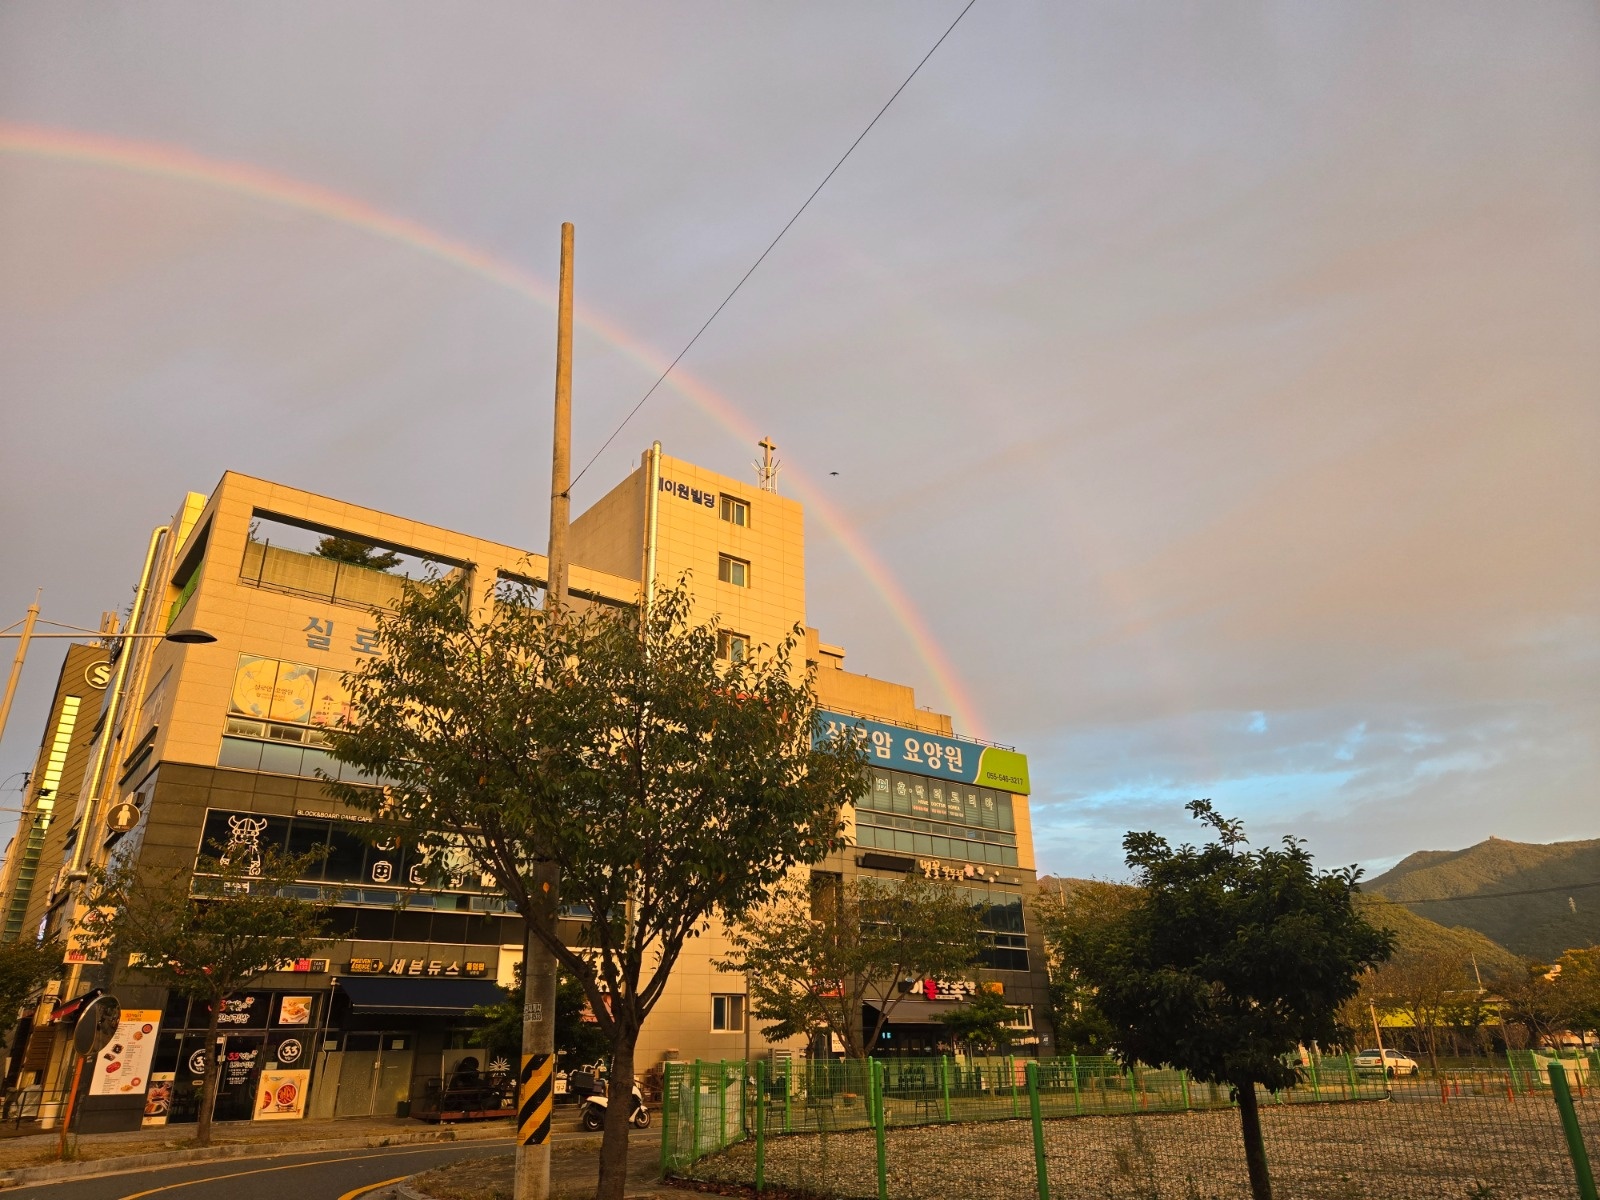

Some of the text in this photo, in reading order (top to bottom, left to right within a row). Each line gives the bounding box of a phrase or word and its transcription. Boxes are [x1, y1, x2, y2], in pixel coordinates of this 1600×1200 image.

[826, 720, 963, 774] 실로암 요양원
[296, 809, 340, 819] BLOCK&BOARD
[388, 958, 460, 976] 세븐듀스
[282, 1046, 298, 1056] 33
